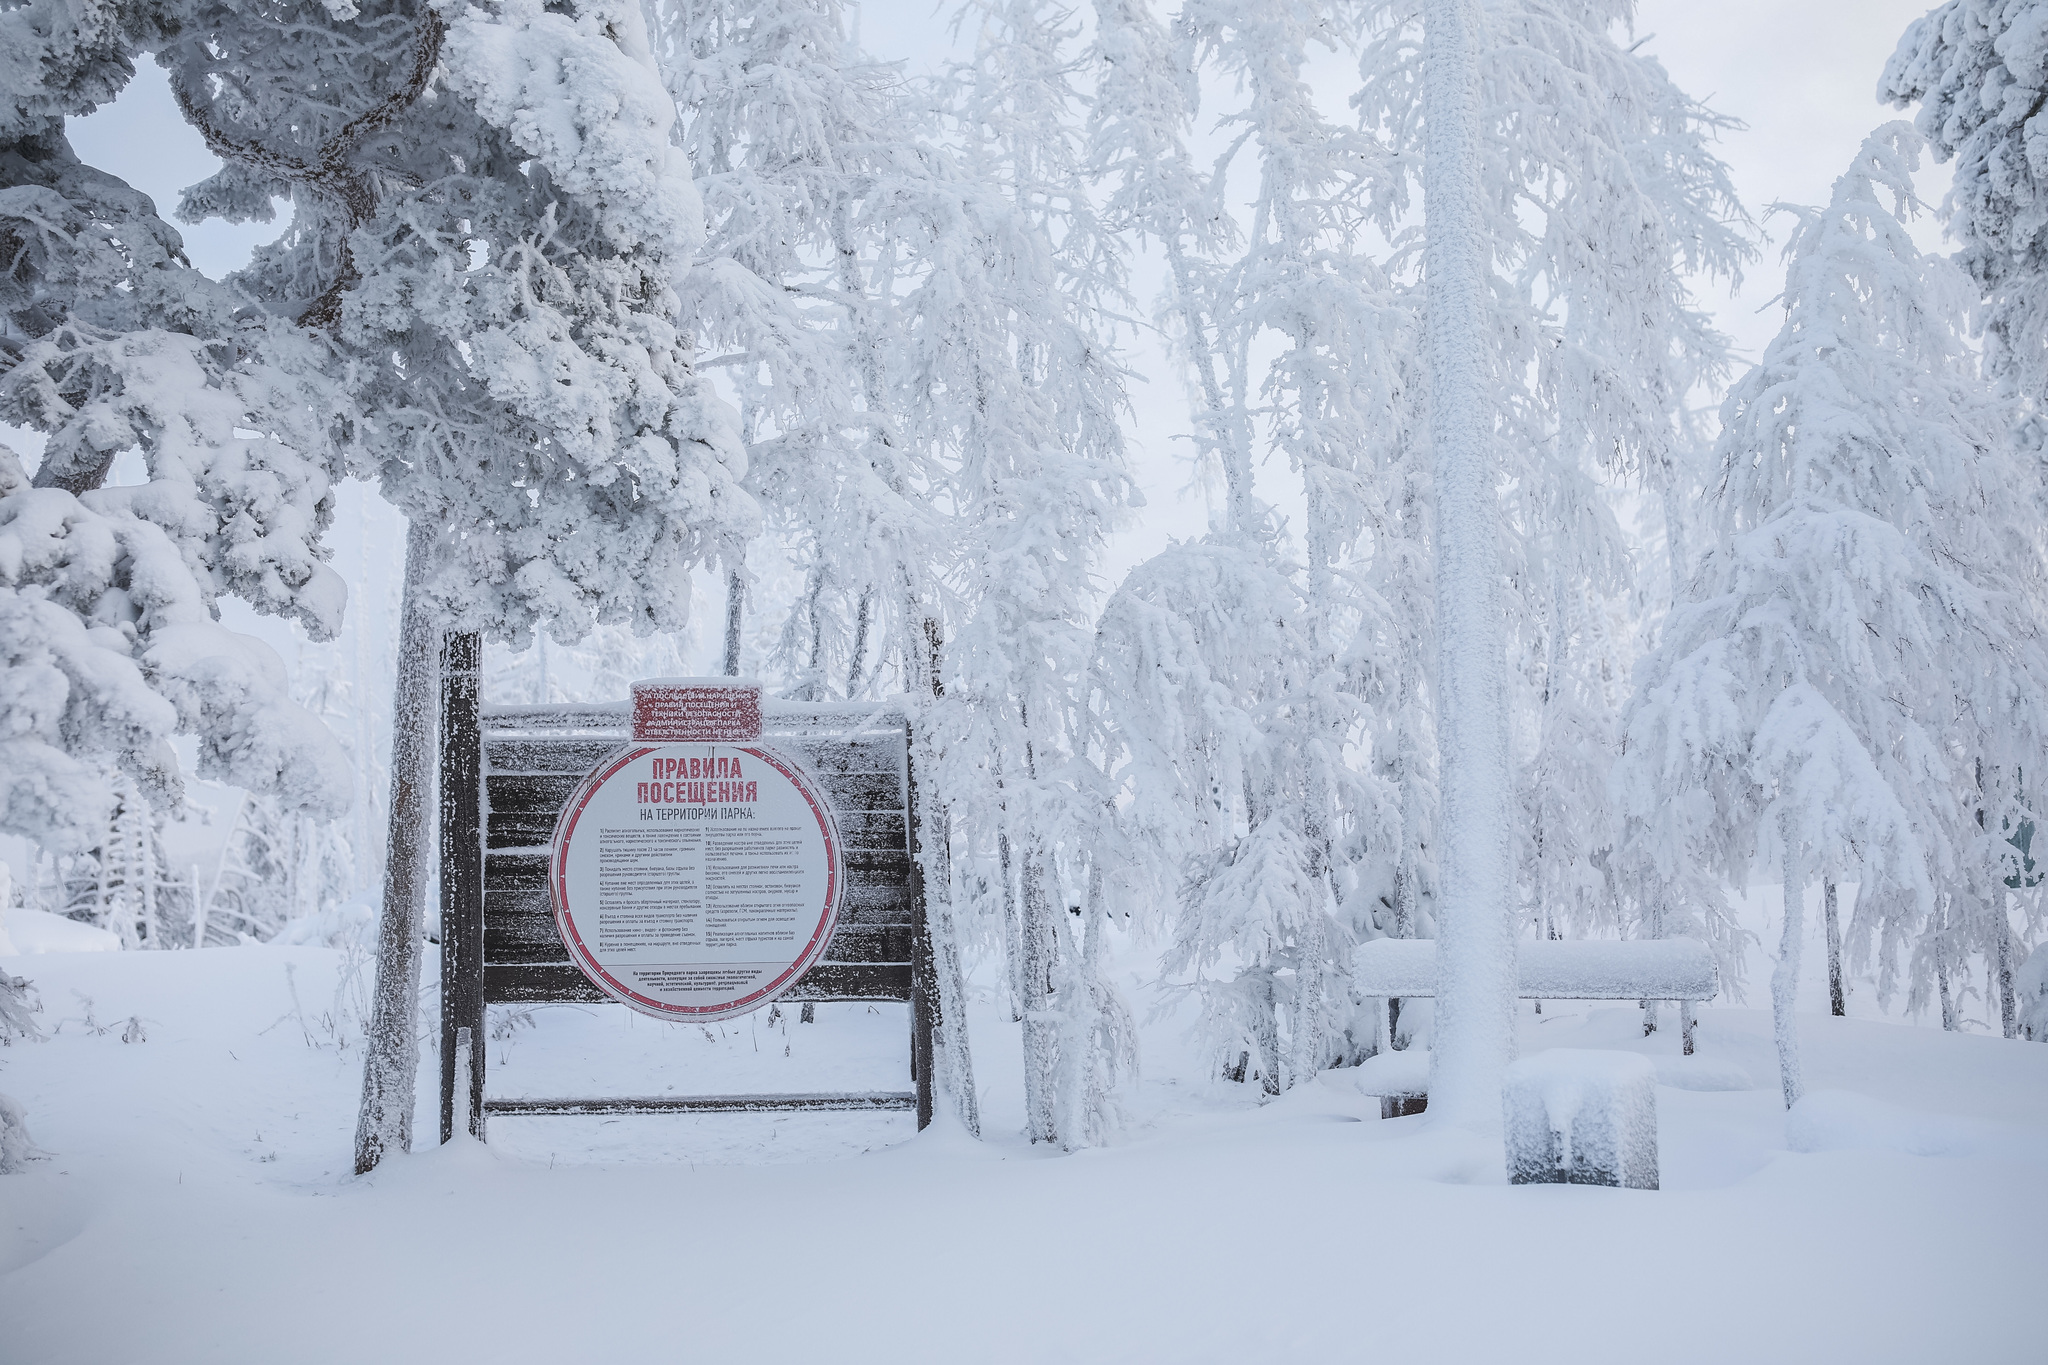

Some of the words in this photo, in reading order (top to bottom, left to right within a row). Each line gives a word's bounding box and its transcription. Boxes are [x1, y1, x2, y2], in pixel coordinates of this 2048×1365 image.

[652, 757, 743, 779] ПРАВИЛА
[637, 781, 757, 806] ПОСЕЩЕНИЯ
[640, 809, 653, 820] НА
[656, 808, 718, 820] ТЕРРИТОРИИ
[720, 807, 756, 820] ПАРКА:
